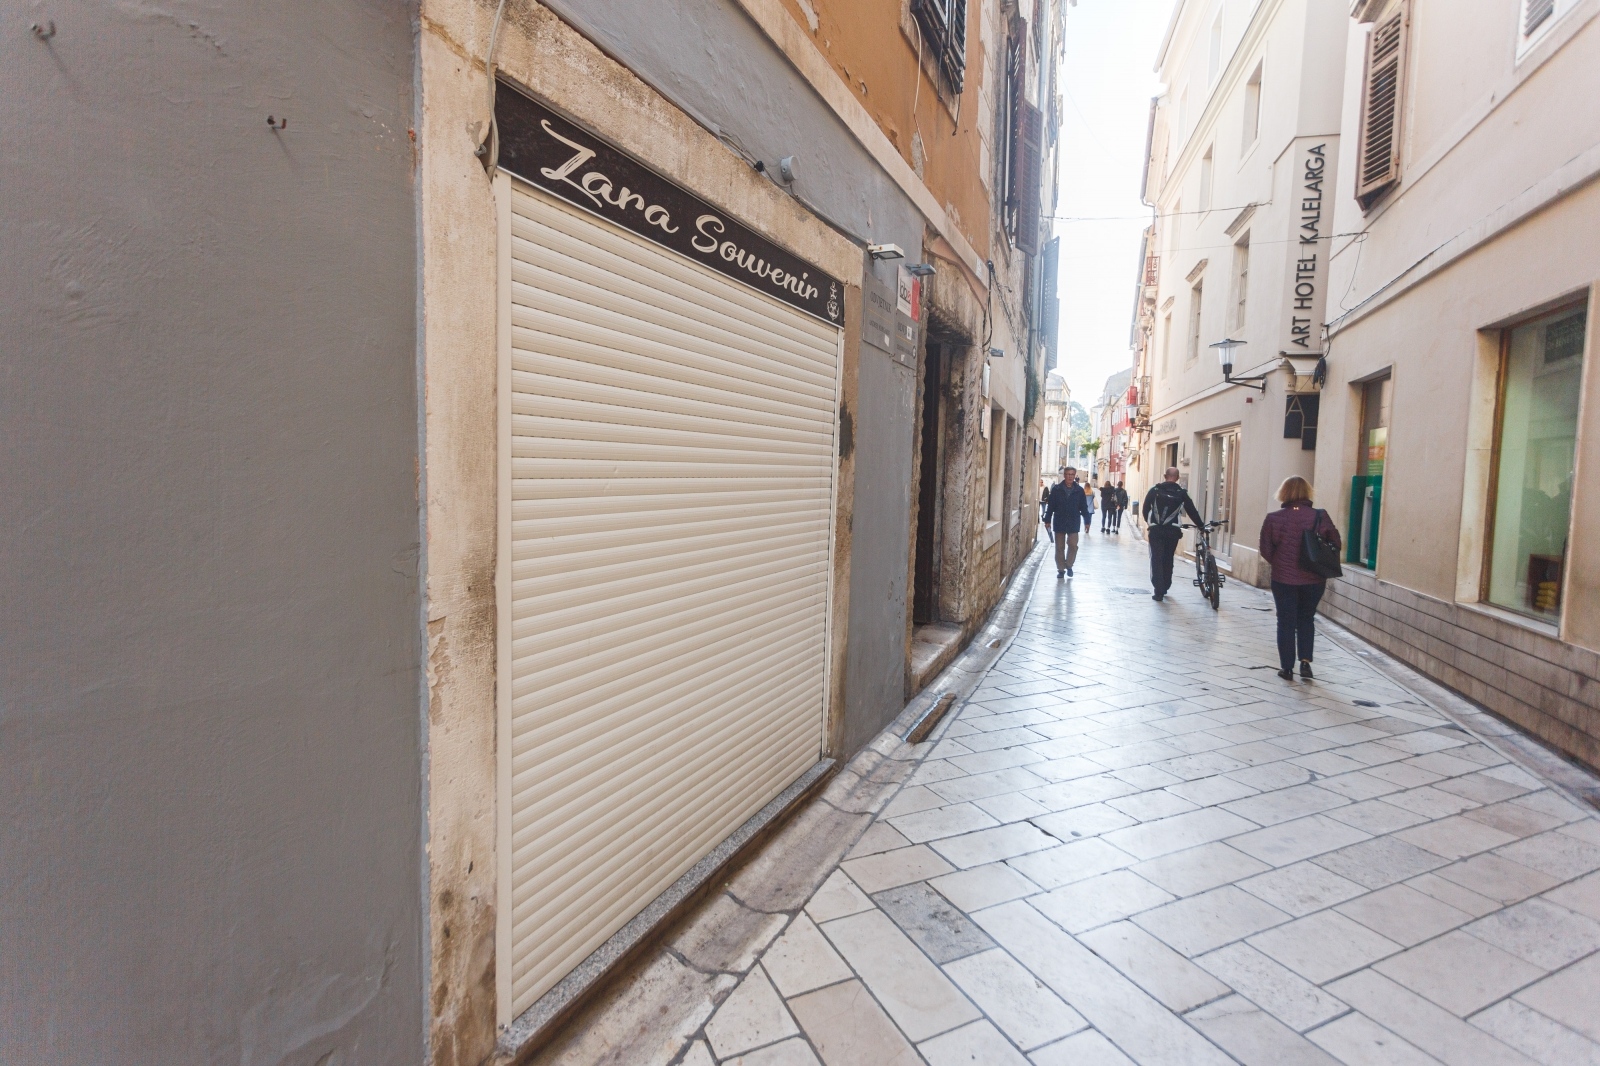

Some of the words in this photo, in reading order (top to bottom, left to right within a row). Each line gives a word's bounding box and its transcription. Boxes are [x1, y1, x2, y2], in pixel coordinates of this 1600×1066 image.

[541, 119, 680, 234] Zara
[692, 214, 819, 300] Souvenir
[1299, 143, 1327, 246] KALELARGA
[1293, 253, 1317, 311] HOTEL
[1291, 315, 1311, 348] ART
